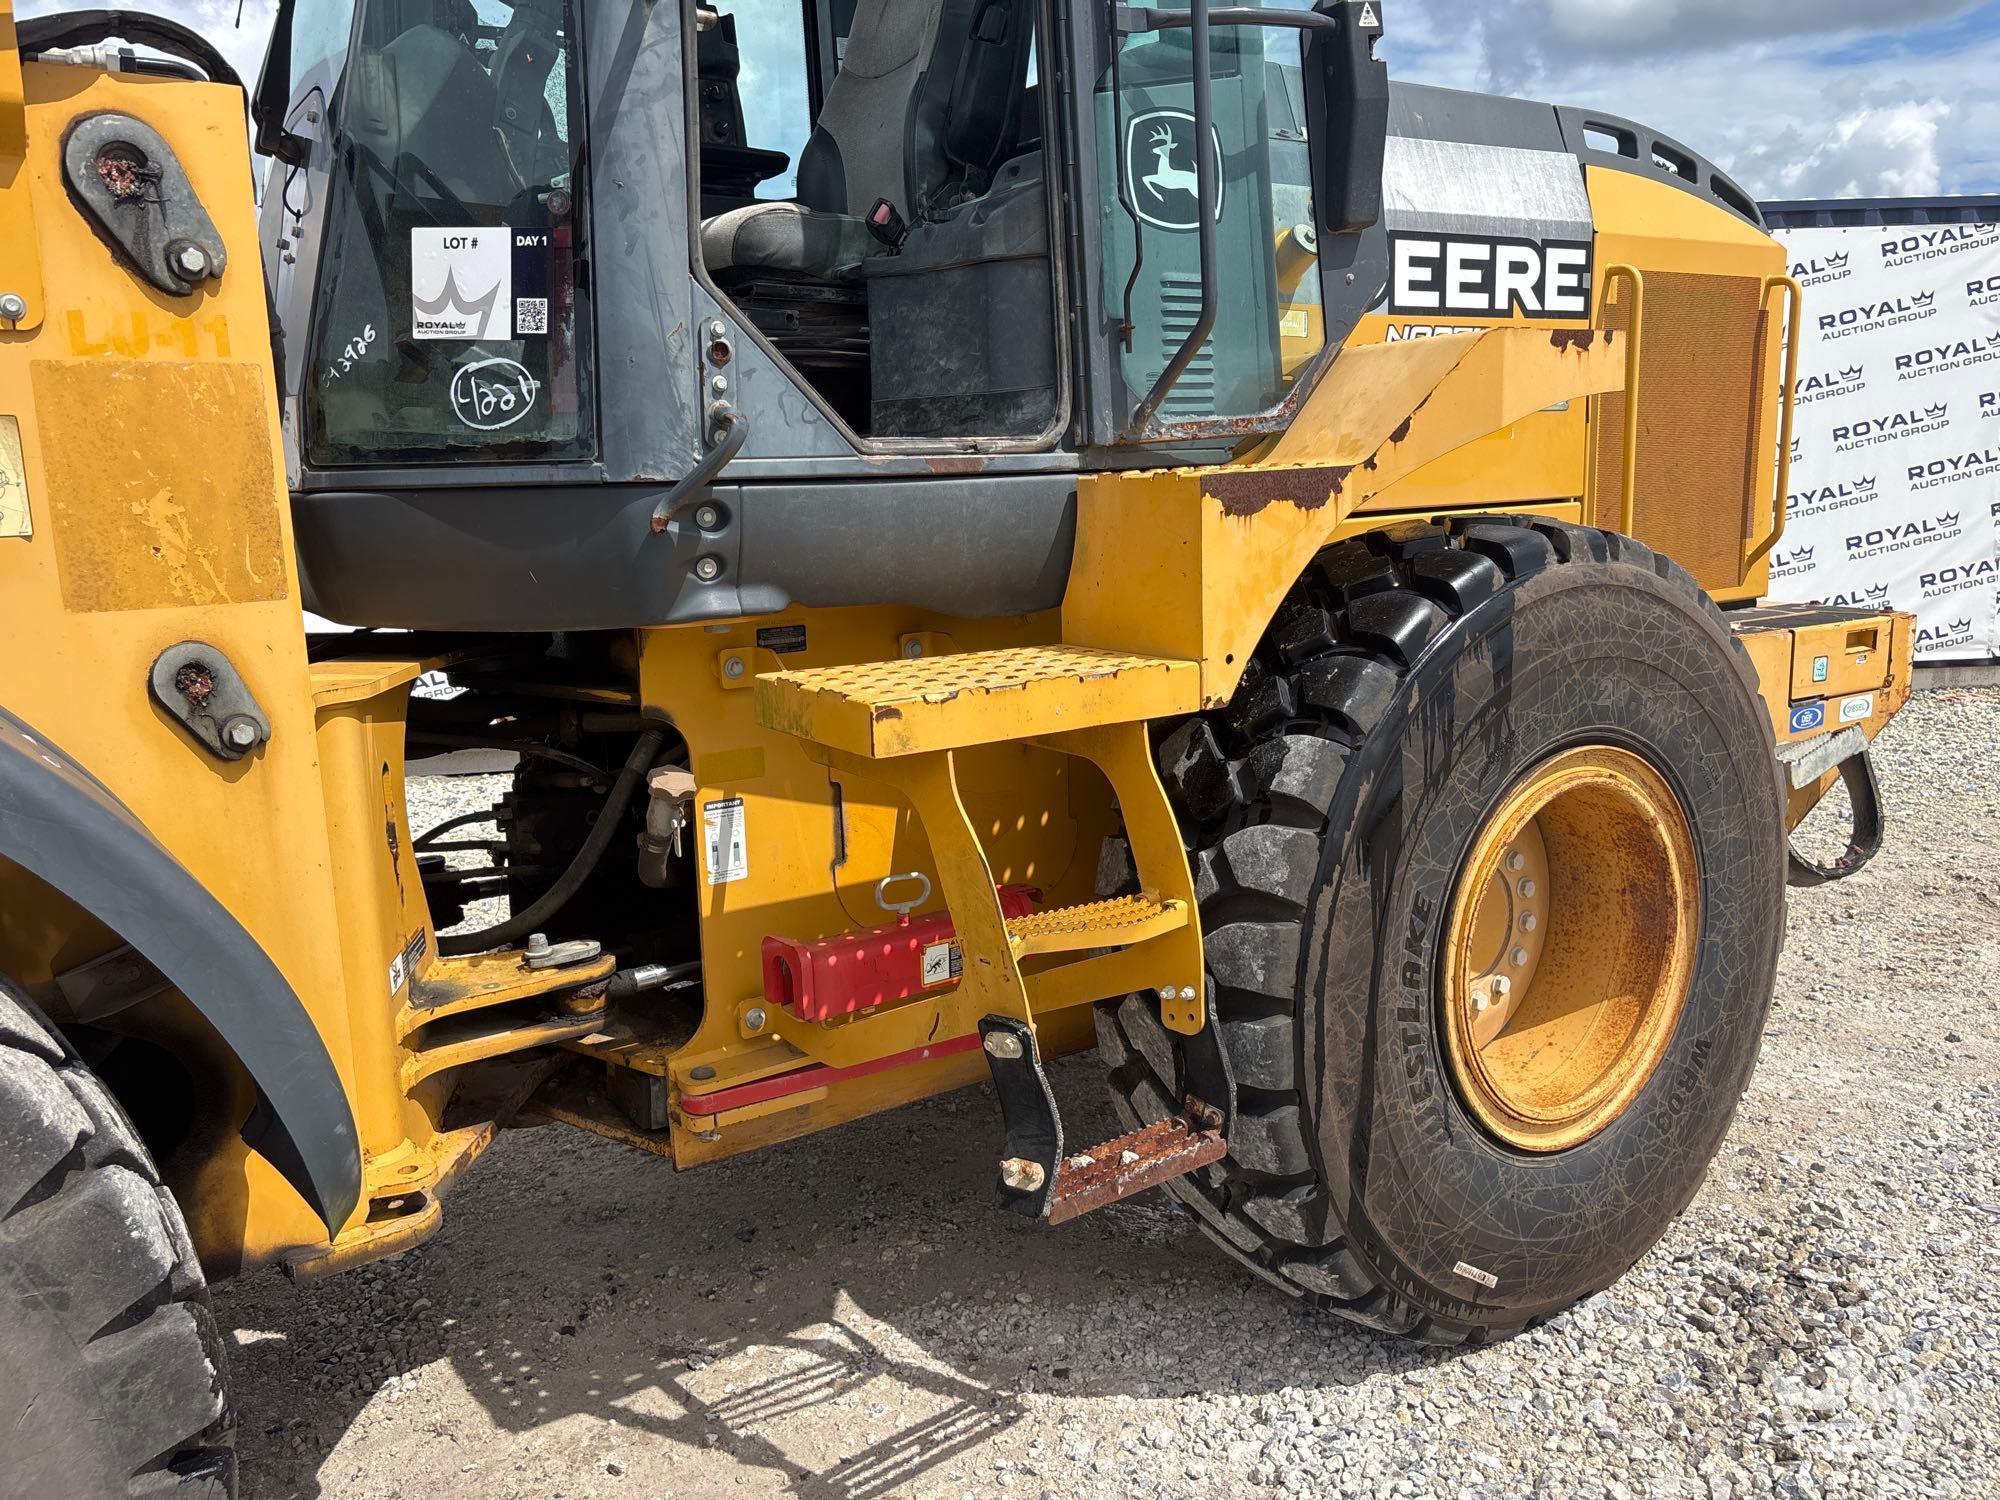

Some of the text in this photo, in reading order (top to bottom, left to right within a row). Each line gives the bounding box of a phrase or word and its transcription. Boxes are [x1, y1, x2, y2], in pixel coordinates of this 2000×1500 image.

[443, 237, 478, 249] LOT #
[516, 236, 547, 246] DAY 1
[1881, 226, 1974, 258] ROYAL
[1884, 235, 1999, 269] AUCTION GROUP
[1375, 238, 1588, 312] EERE
[1801, 269, 1852, 288] GROUP
[416, 321, 456, 329] ROYAL
[1818, 298, 1912, 331] ROYAL
[1822, 308, 1937, 342] AUCTION GROUP
[1895, 338, 1987, 371] ROYAL
[1897, 351, 2000, 382] AUCTION GROU
[1815, 382, 1866, 401] GROUP
[1832, 410, 1925, 443] ROYAL
[1835, 419, 1951, 454] AUCTION GROUP
[1908, 449, 1998, 481] ROYAL
[1910, 470, 1972, 492] AUCTION
[1784, 492, 1879, 521] CTION GROUP
[1785, 483, 1853, 510] OYAL
[1846, 519, 1937, 552] ROYAL
[1848, 528, 1962, 562] AUCTION GROUP
[1923, 577, 1984, 599] AUCTION
[1924, 634, 1975, 653] GROUP
[1847, 703, 1866, 714] DIESEL
[706, 799, 741, 811] IMPORTANT
